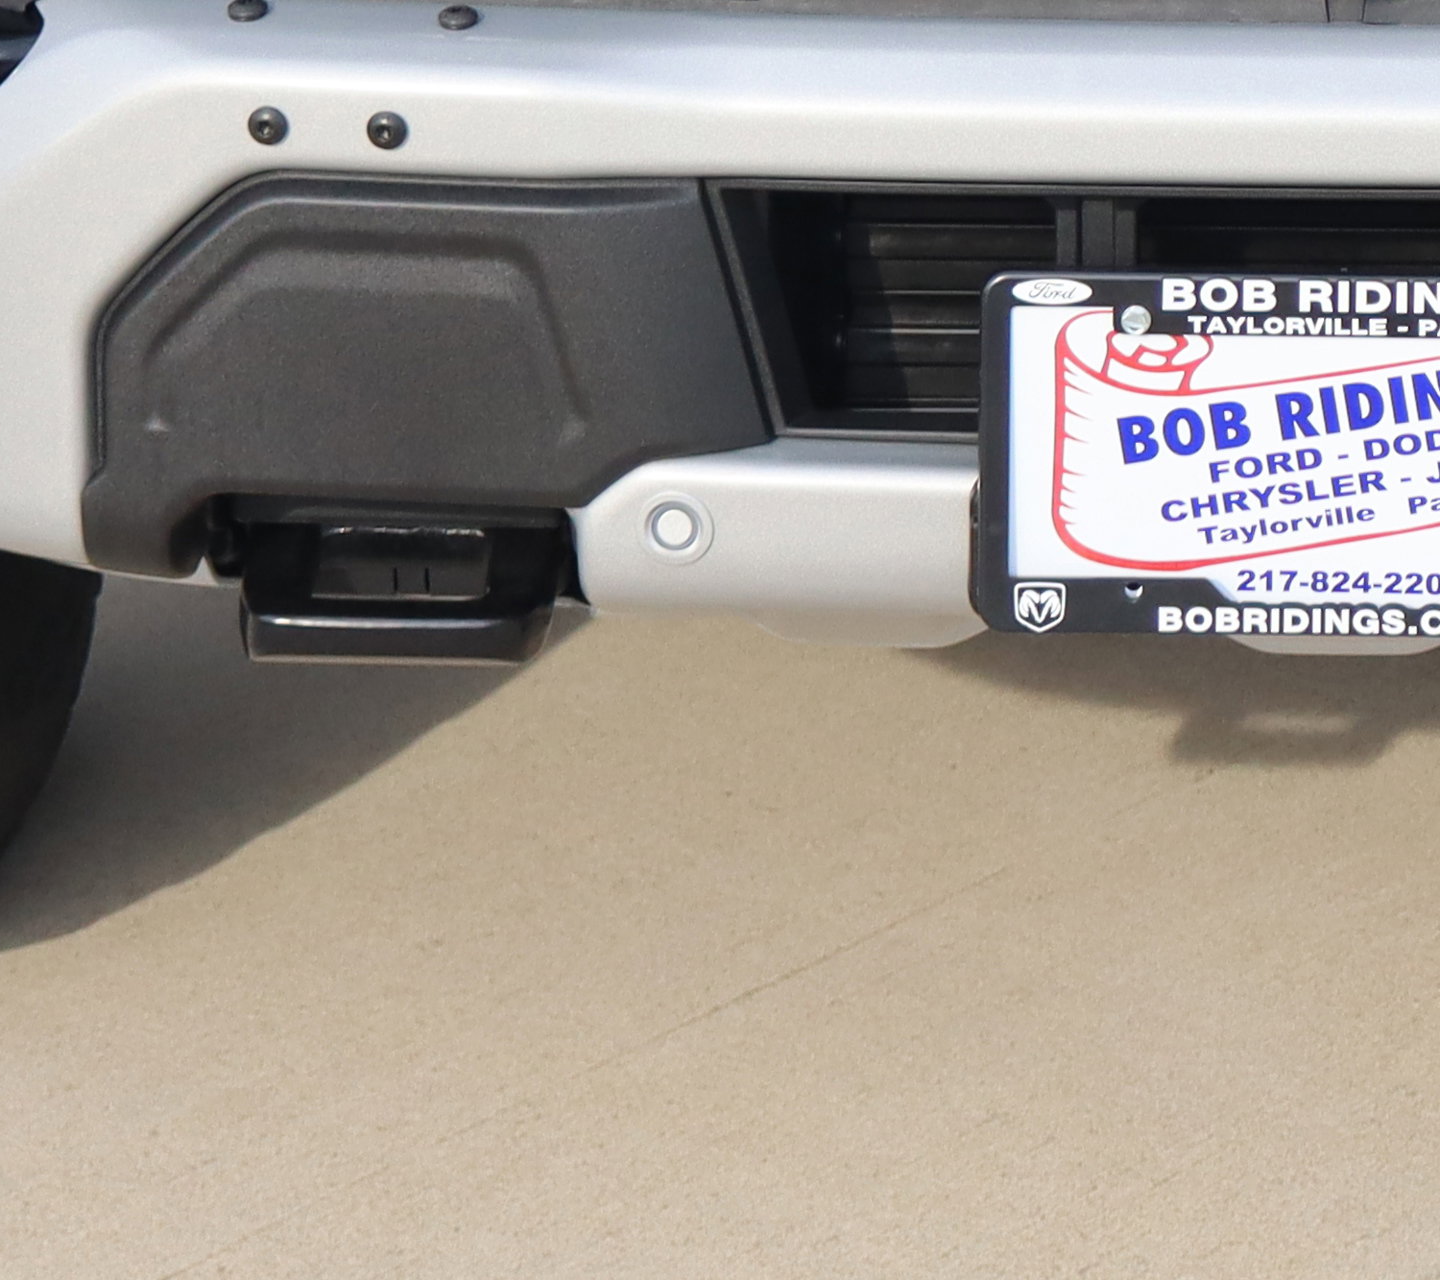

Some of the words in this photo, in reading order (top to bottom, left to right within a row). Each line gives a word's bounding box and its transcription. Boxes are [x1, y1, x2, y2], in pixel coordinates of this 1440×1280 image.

[1028, 281, 1077, 300] Ford
[1162, 278, 1277, 312] BOB
[1187, 315, 1388, 337] TAYLORVILLE
[1117, 401, 1252, 465] BOB
[1209, 447, 1323, 484] FORD
[1161, 471, 1388, 524] CHRYSLER
[1198, 507, 1376, 545] Taylorville
